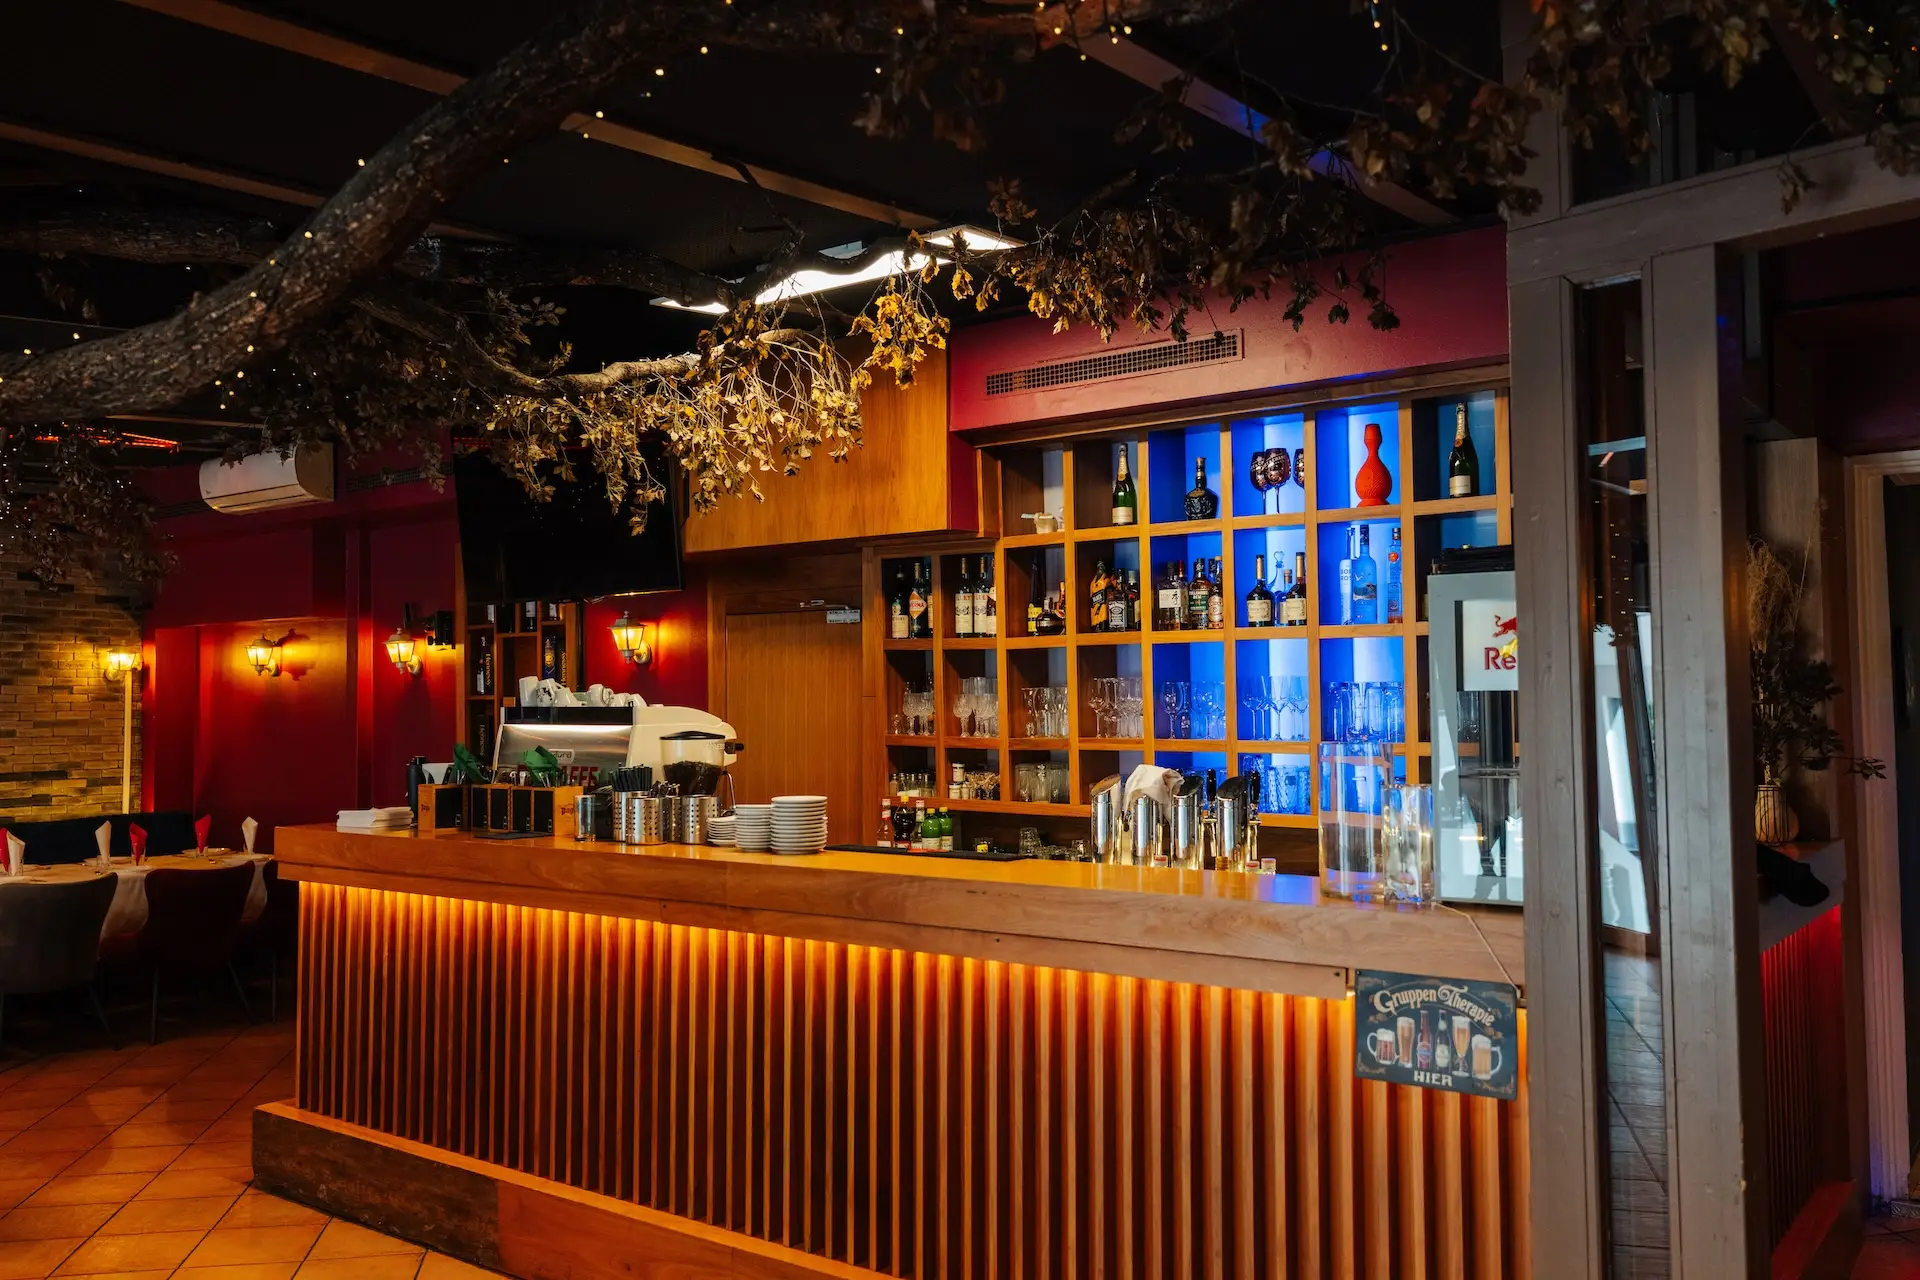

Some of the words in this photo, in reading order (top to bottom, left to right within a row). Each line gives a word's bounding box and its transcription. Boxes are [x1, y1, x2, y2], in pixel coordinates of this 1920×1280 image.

[1484, 647, 1517, 670] Re
[1373, 988, 1437, 1015] Gruppen
[1438, 984, 1495, 1027] Therapie
[1413, 1070, 1453, 1087] HIER
